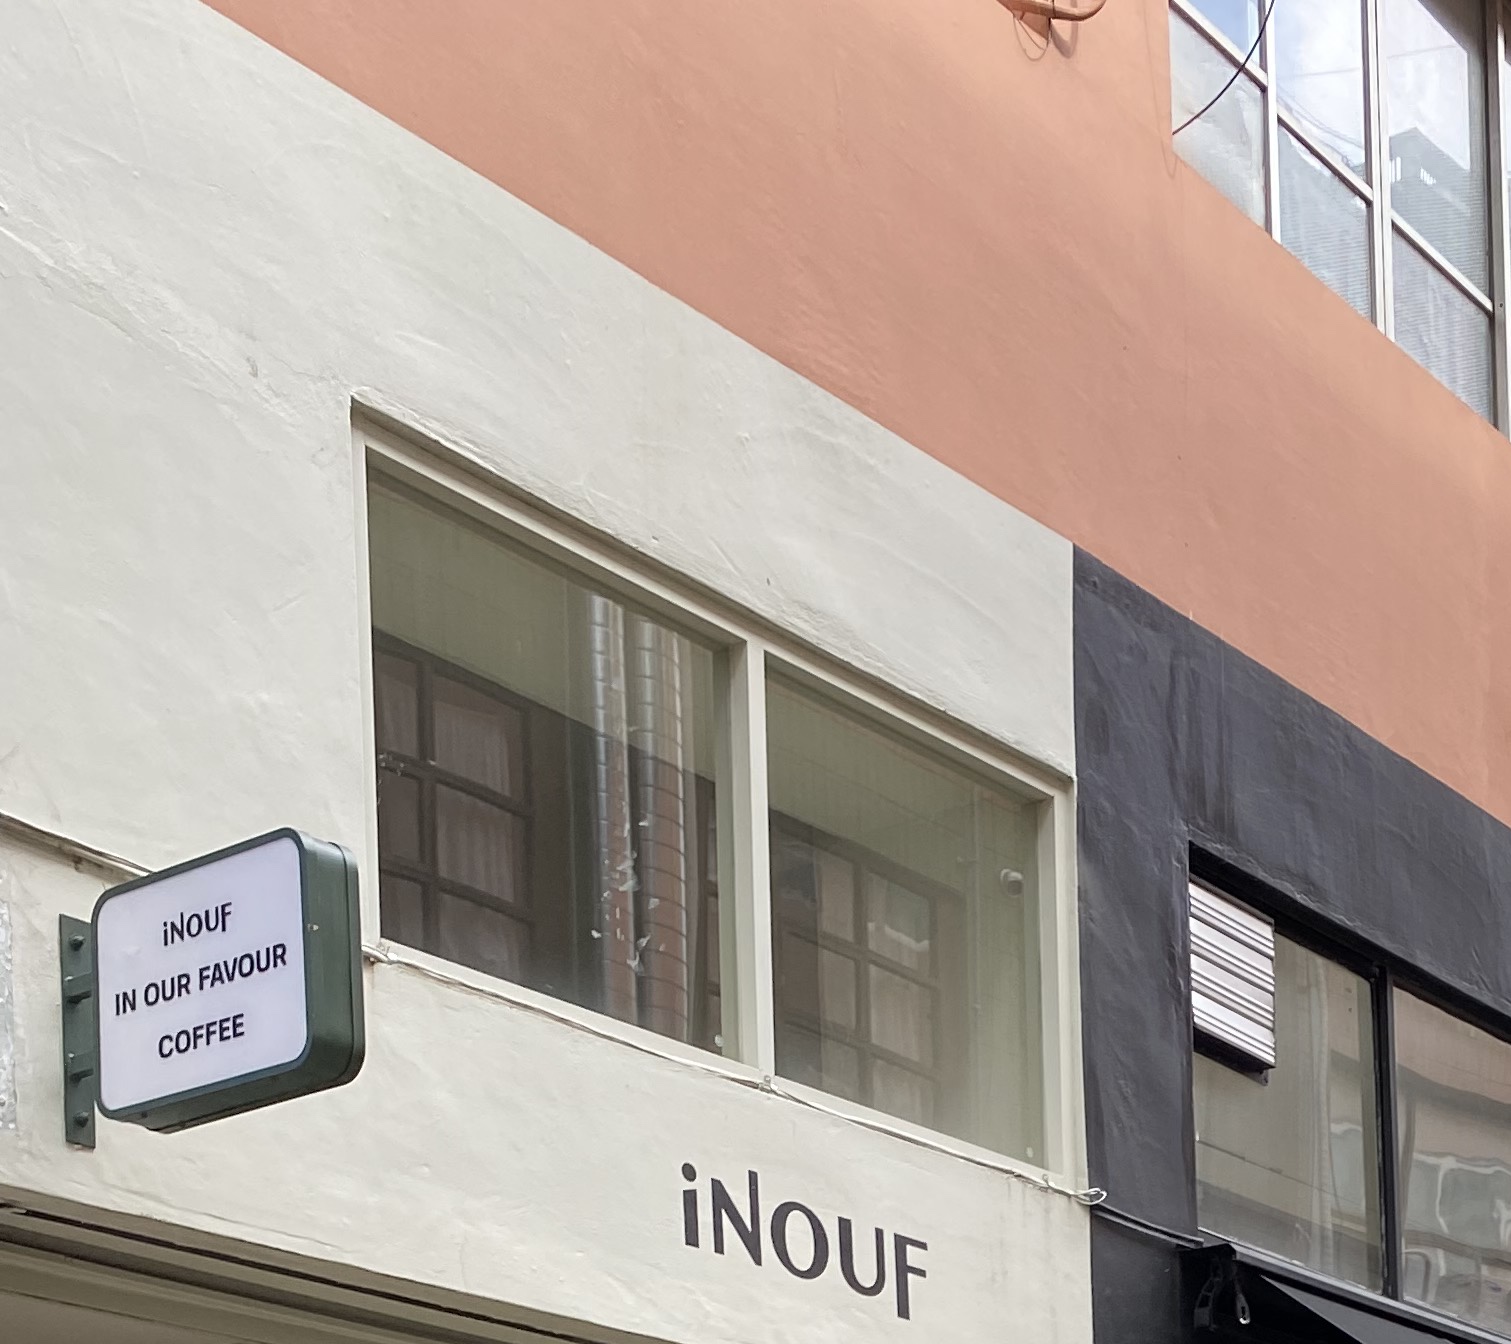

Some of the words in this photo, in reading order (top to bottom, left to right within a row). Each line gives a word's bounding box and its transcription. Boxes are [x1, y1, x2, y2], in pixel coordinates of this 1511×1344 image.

[163, 902, 233, 947] iNOUF
[114, 989, 137, 1017] IN
[143, 974, 191, 1008] OUR
[198, 943, 288, 992] FAVOUR
[157, 1013, 245, 1060] COFFEE
[680, 1162, 928, 1321] iNOUF
